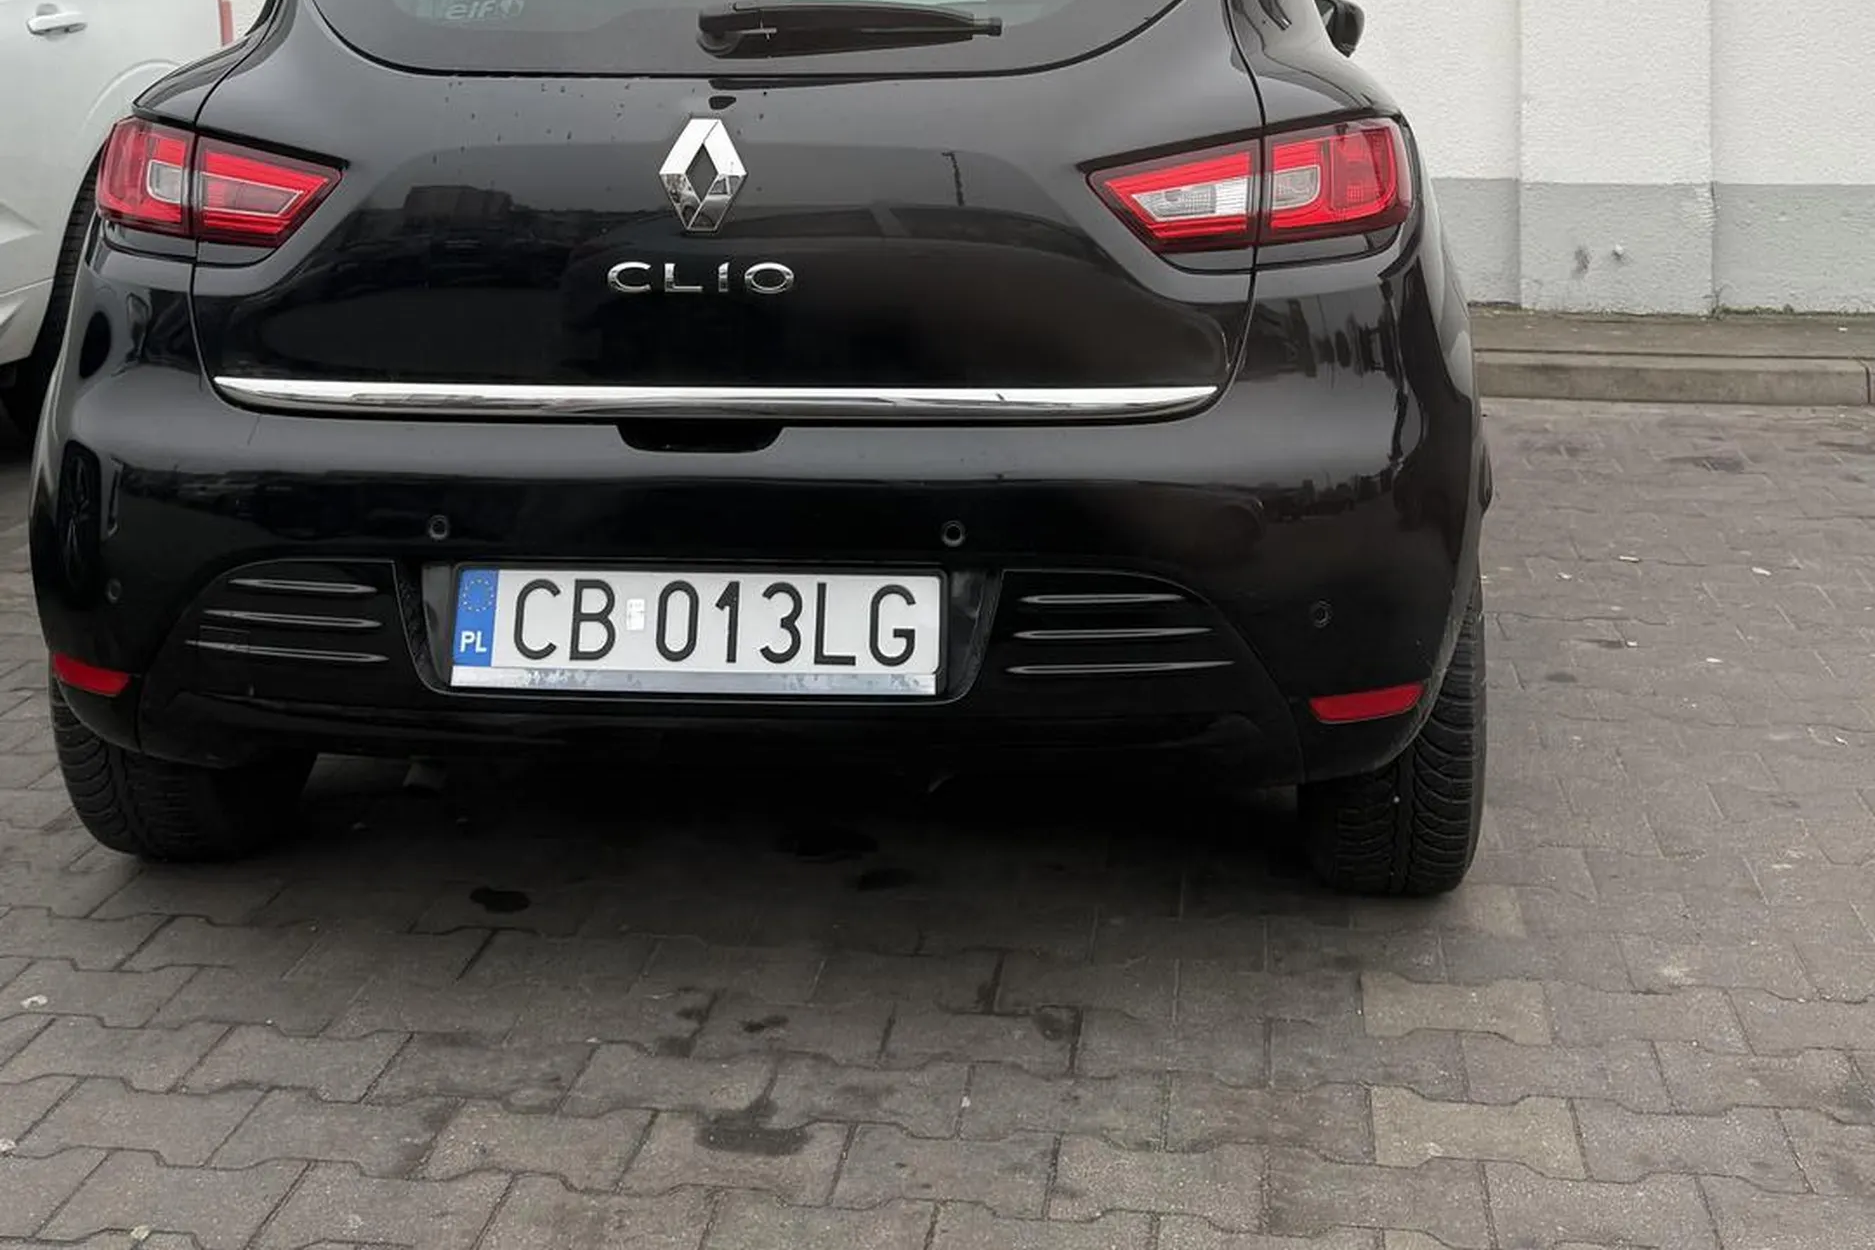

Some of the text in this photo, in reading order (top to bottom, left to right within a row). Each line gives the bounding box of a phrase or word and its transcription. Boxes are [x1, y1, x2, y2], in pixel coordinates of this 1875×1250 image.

[607, 261, 795, 294] CLIO
[513, 578, 916, 667] CB 013LG
[460, 630, 488, 653] PL
